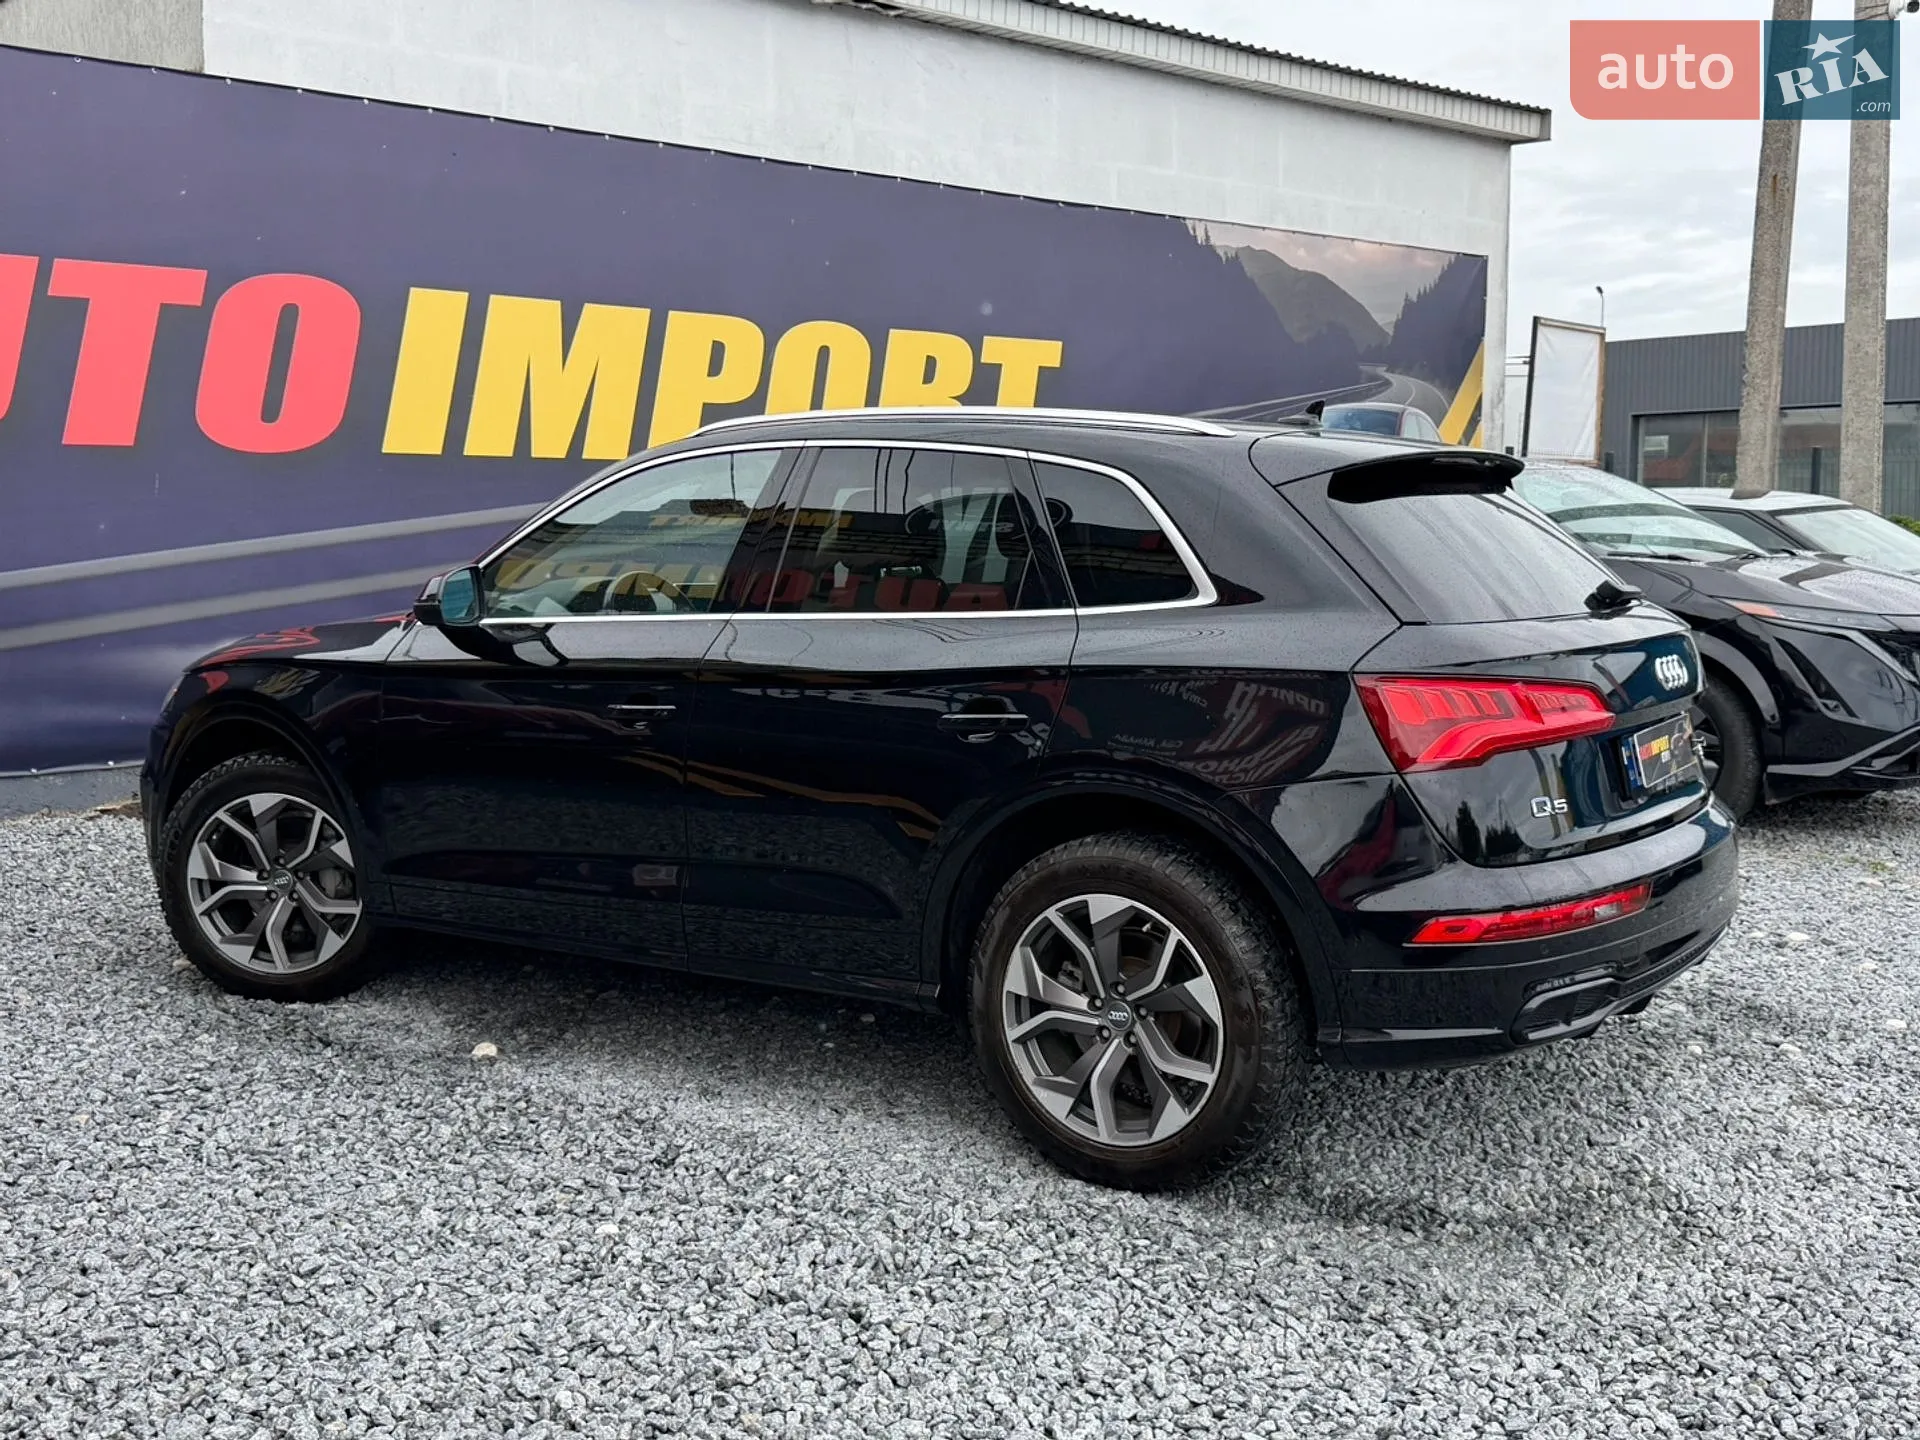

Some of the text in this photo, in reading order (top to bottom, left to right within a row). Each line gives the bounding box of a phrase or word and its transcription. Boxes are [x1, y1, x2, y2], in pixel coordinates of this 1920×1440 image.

[0, 253, 1063, 460] TO IMPORT
[1531, 796, 1569, 818] Q5
